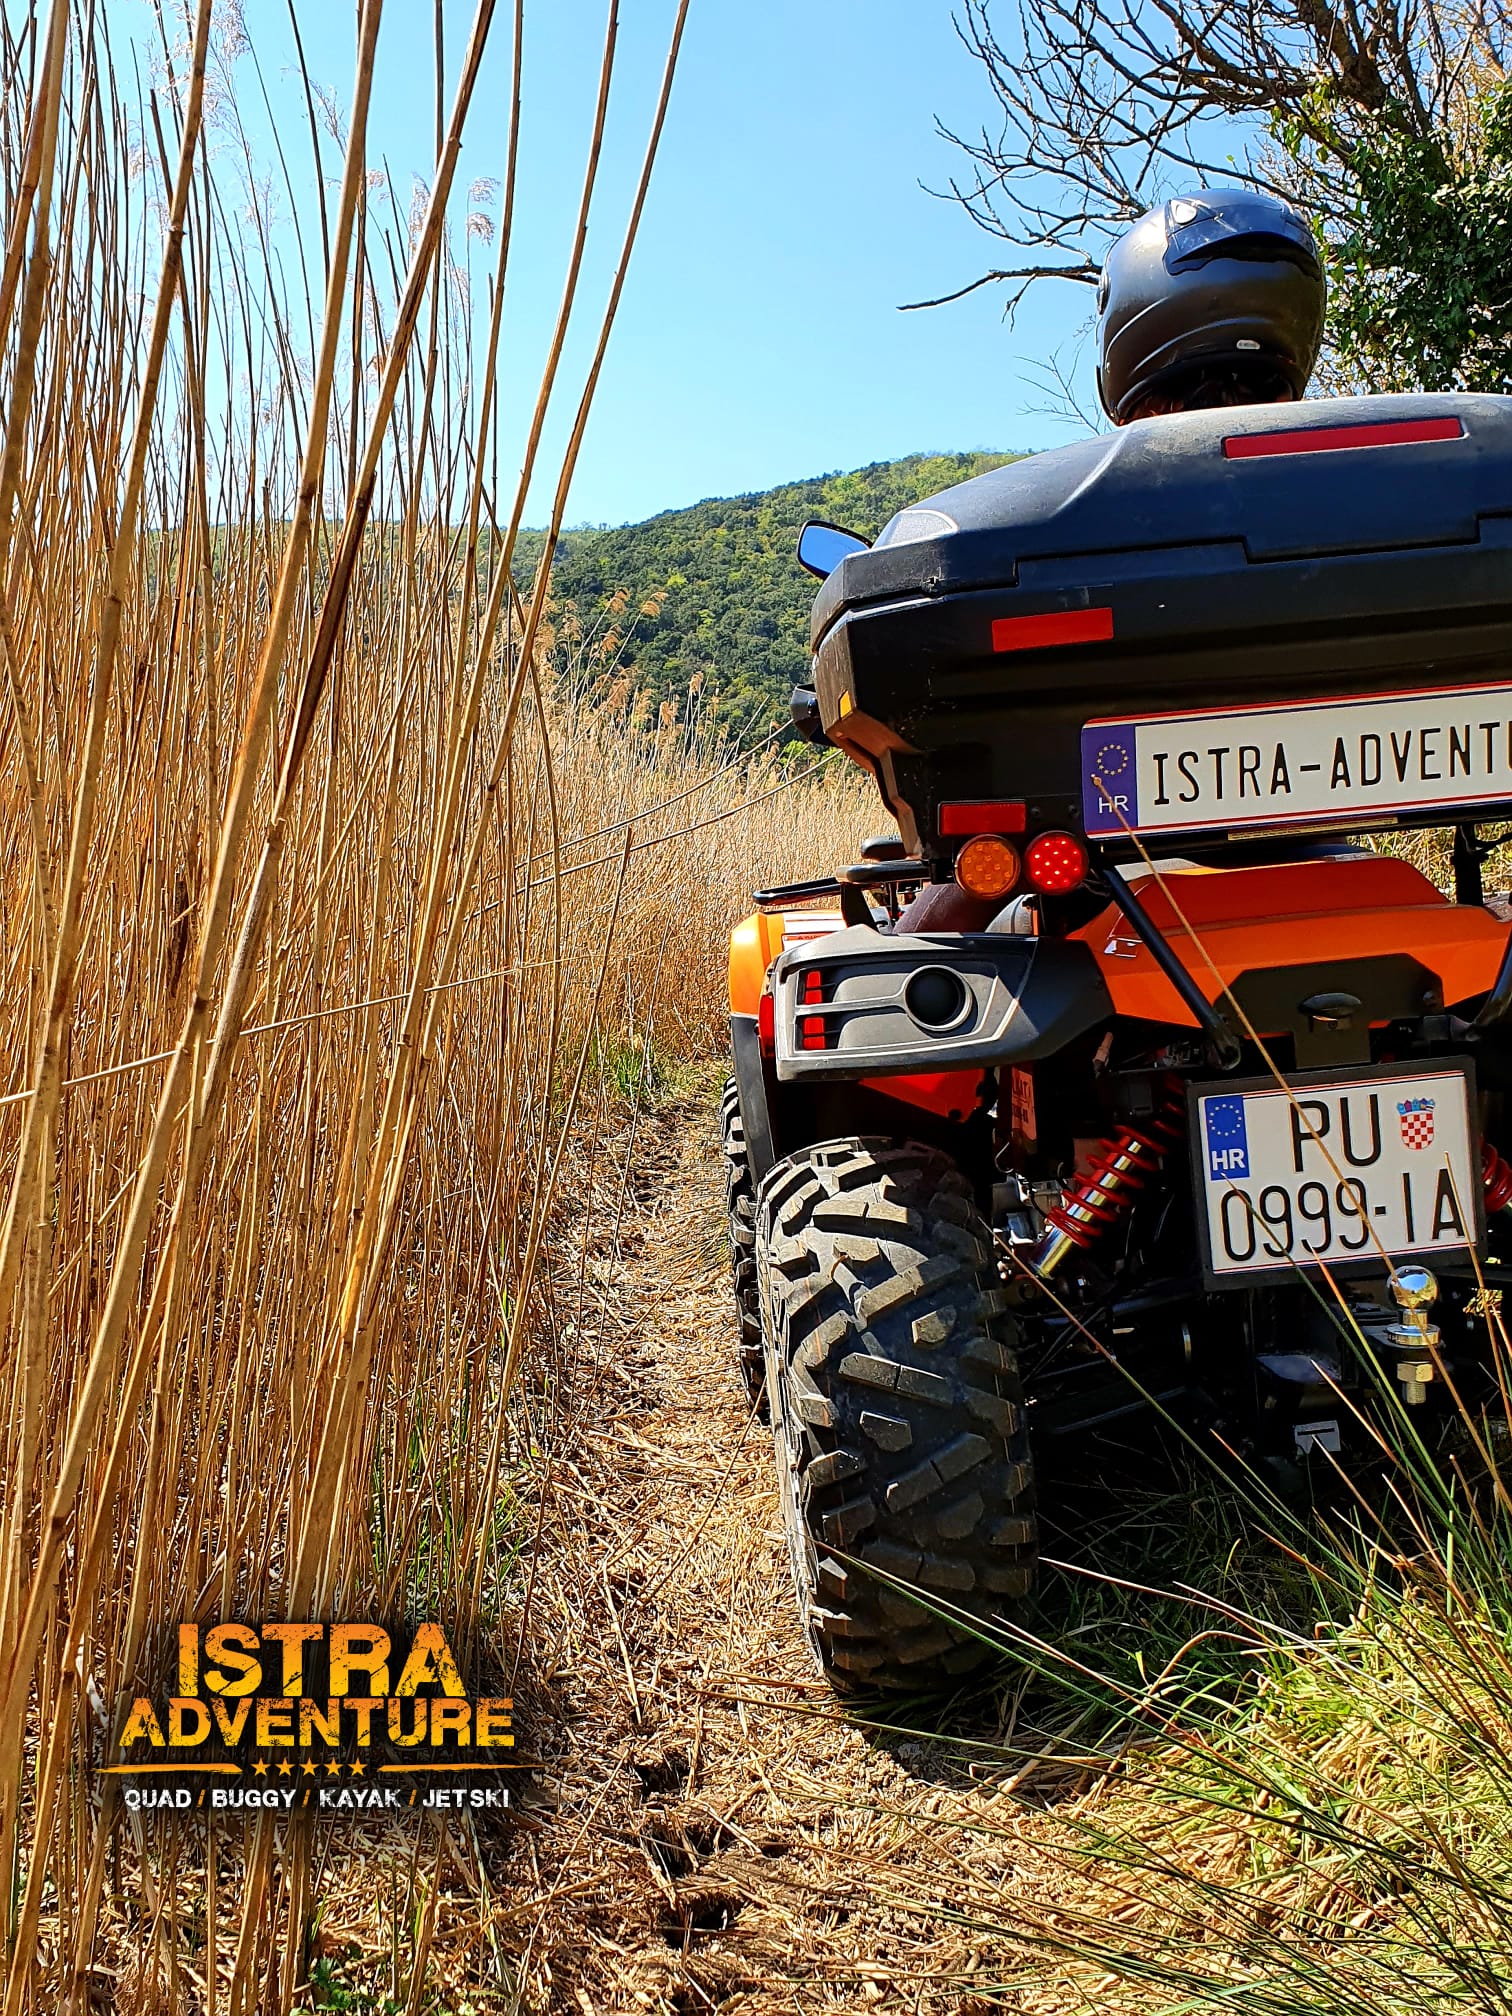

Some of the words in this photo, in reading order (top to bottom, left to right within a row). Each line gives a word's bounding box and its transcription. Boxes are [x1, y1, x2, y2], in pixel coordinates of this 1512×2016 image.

[1098, 795, 1129, 814] HR
[1289, 1093, 1382, 1172] PU
[1210, 1147, 1245, 1171] HR
[1220, 1168, 1465, 1262] 0999-IA
